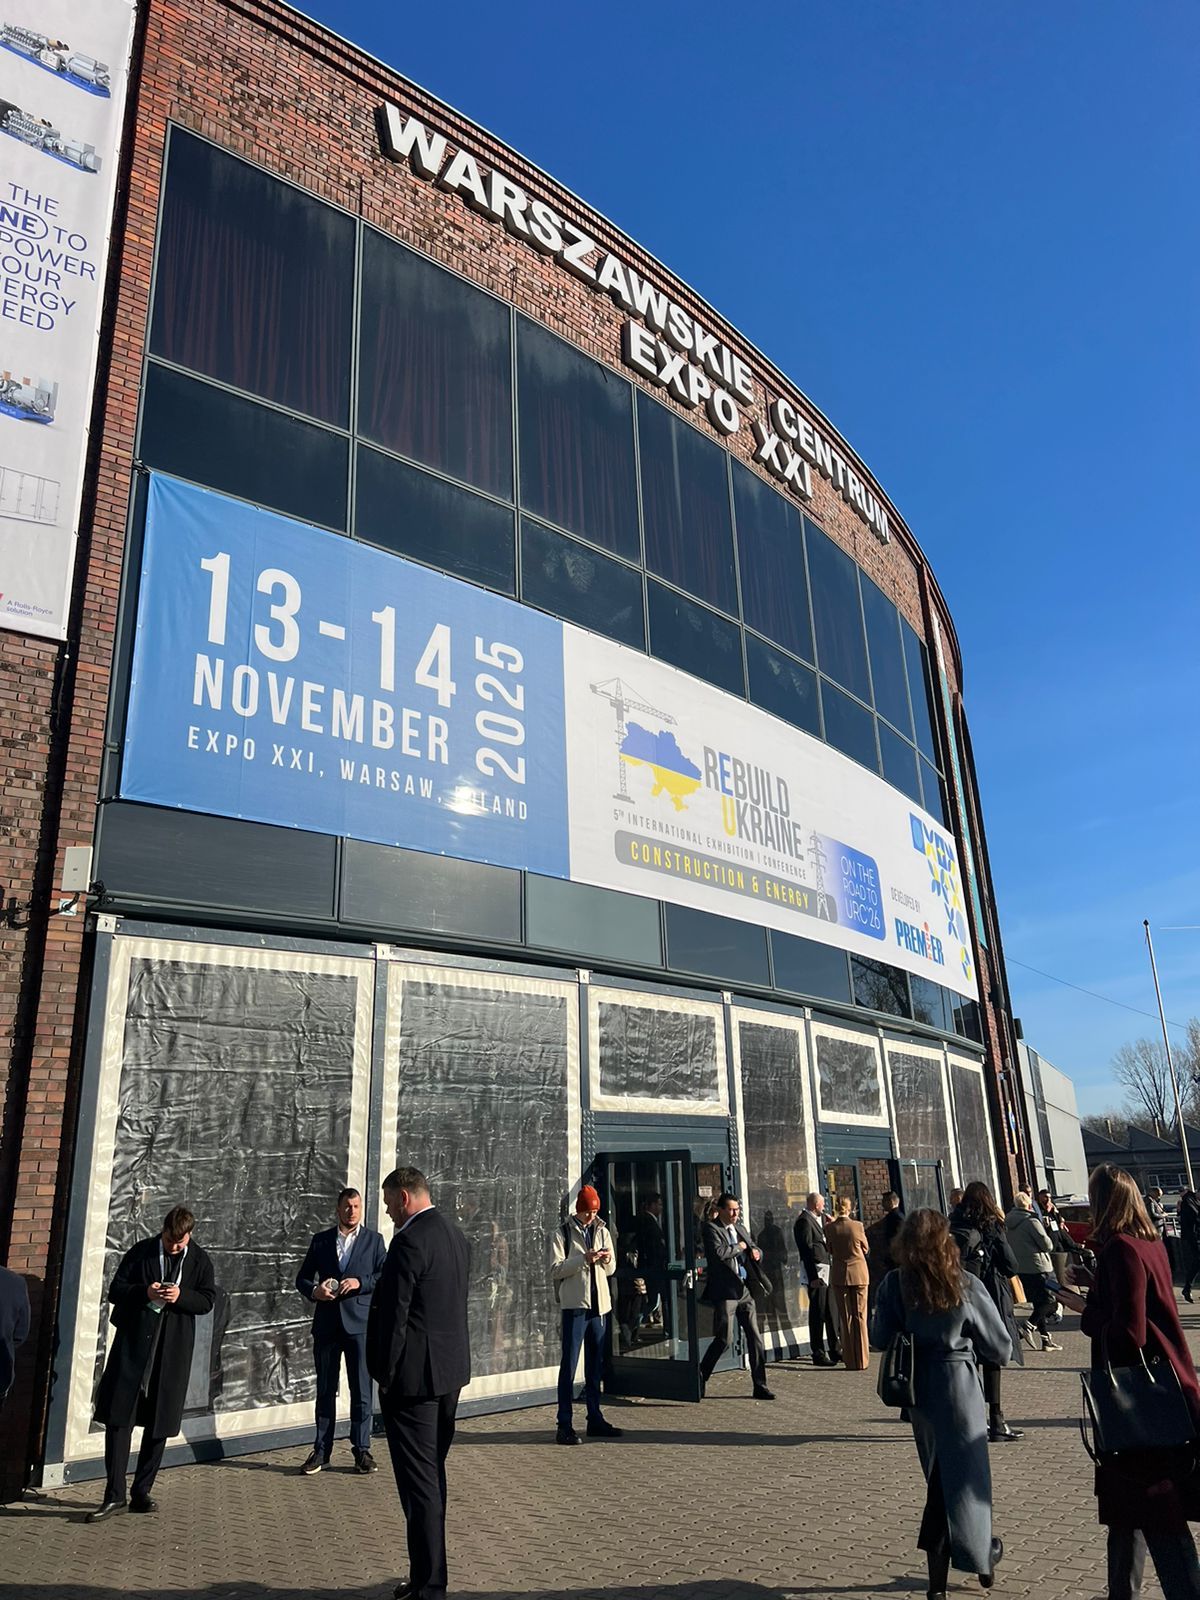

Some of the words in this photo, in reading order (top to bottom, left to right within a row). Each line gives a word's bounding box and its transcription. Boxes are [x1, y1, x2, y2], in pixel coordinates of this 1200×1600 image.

[0, 206, 38, 235] NE
[53, 226, 88, 252] TO
[8, 182, 59, 218] THE
[0, 230, 96, 281] POWER
[0, 252, 61, 290] OUR
[0, 274, 76, 315] ERGY
[2, 299, 55, 331] EED
[380, 101, 755, 405] WARSZAWSKIE
[771, 397, 890, 544] CENTRUM
[622, 318, 740, 437] EXPO
[752, 415, 812, 498] XXI
[193, 653, 449, 765] NOVEMBER
[475, 636, 526, 785] 2025
[188, 726, 255, 760] EXPO
[272, 744, 324, 777] XXI,
[340, 758, 442, 803] WARSAW,
[455, 786, 528, 820] LAND
[703, 745, 790, 818] REBUILD
[628, 812, 702, 845] INTERNATIONAL
[707, 837, 754, 861] EXHIBITION
[763, 855, 806, 880] CONFERENCE
[721, 794, 804, 861] UKRAINE
[631, 841, 744, 890] CONSTRUCTION
[752, 876, 759, 893] &
[765, 880, 809, 909] ENERGY
[840, 855, 857, 879] ON
[857, 862, 876, 888] THE
[843, 877, 866, 901] ROAD
[866, 887, 878, 906] TO
